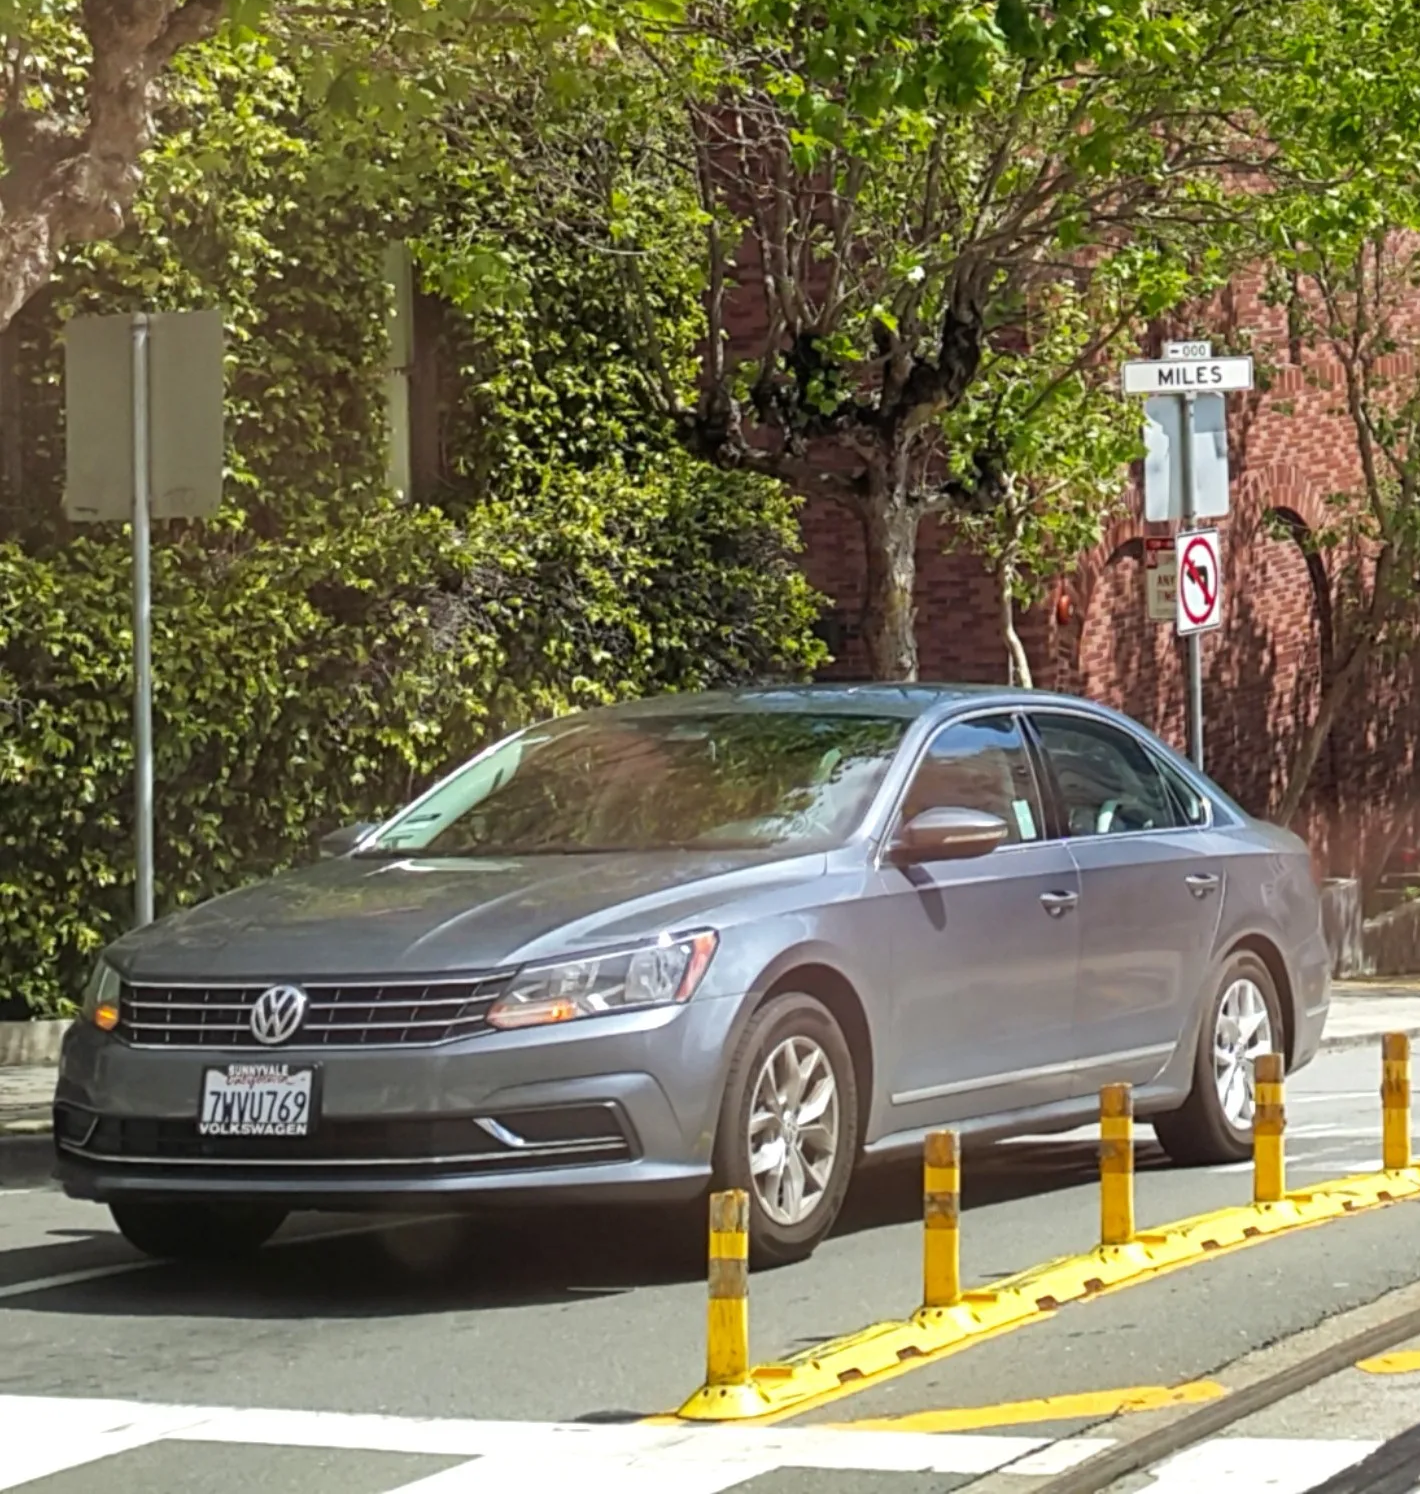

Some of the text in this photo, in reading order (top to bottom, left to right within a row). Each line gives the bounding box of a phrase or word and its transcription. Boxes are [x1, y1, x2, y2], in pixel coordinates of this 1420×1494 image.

[1158, 366, 1222, 386] MILES
[228, 1064, 289, 1077] SUNNYVALE
[209, 1090, 307, 1124] 7WVU769
[199, 1122, 308, 1136] VOLKSWAGEN
